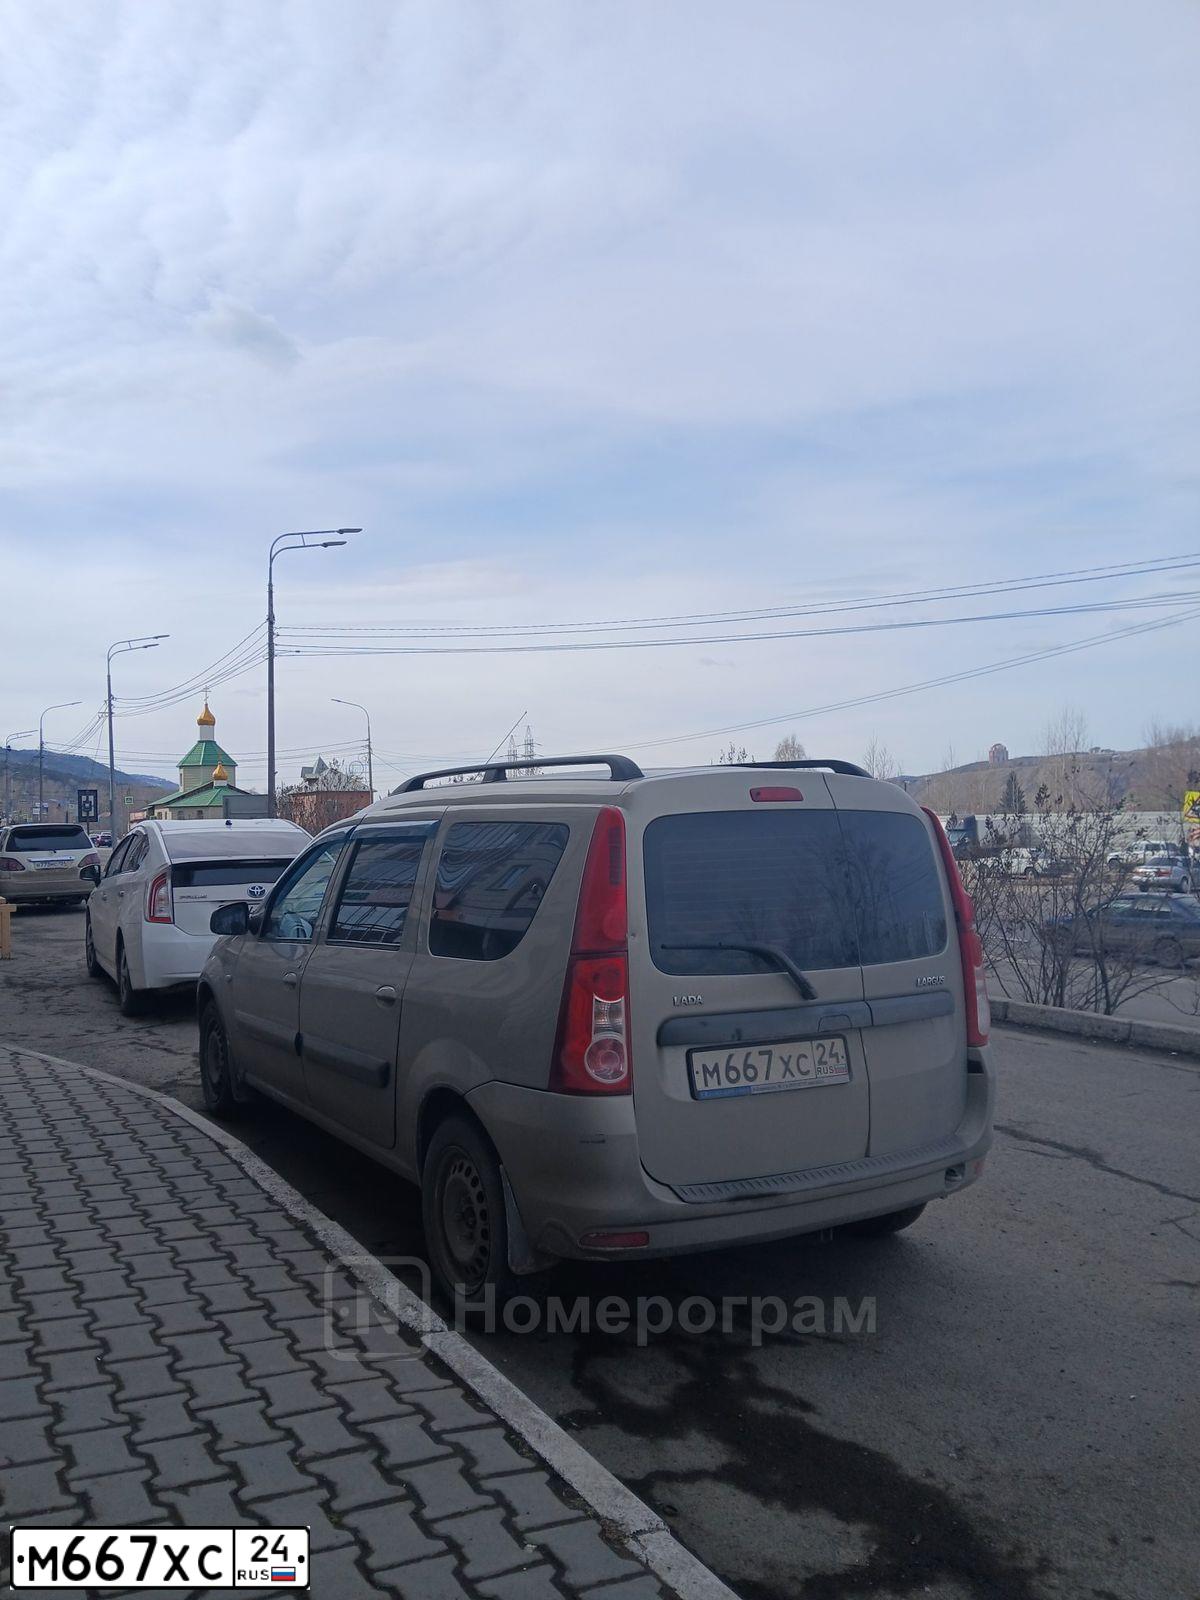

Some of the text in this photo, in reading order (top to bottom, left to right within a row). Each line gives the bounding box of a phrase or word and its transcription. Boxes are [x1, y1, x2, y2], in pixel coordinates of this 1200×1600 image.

[673, 995, 703, 1007] LADA
[816, 1042, 839, 1066] 24
[816, 1065, 835, 1076] RUS
